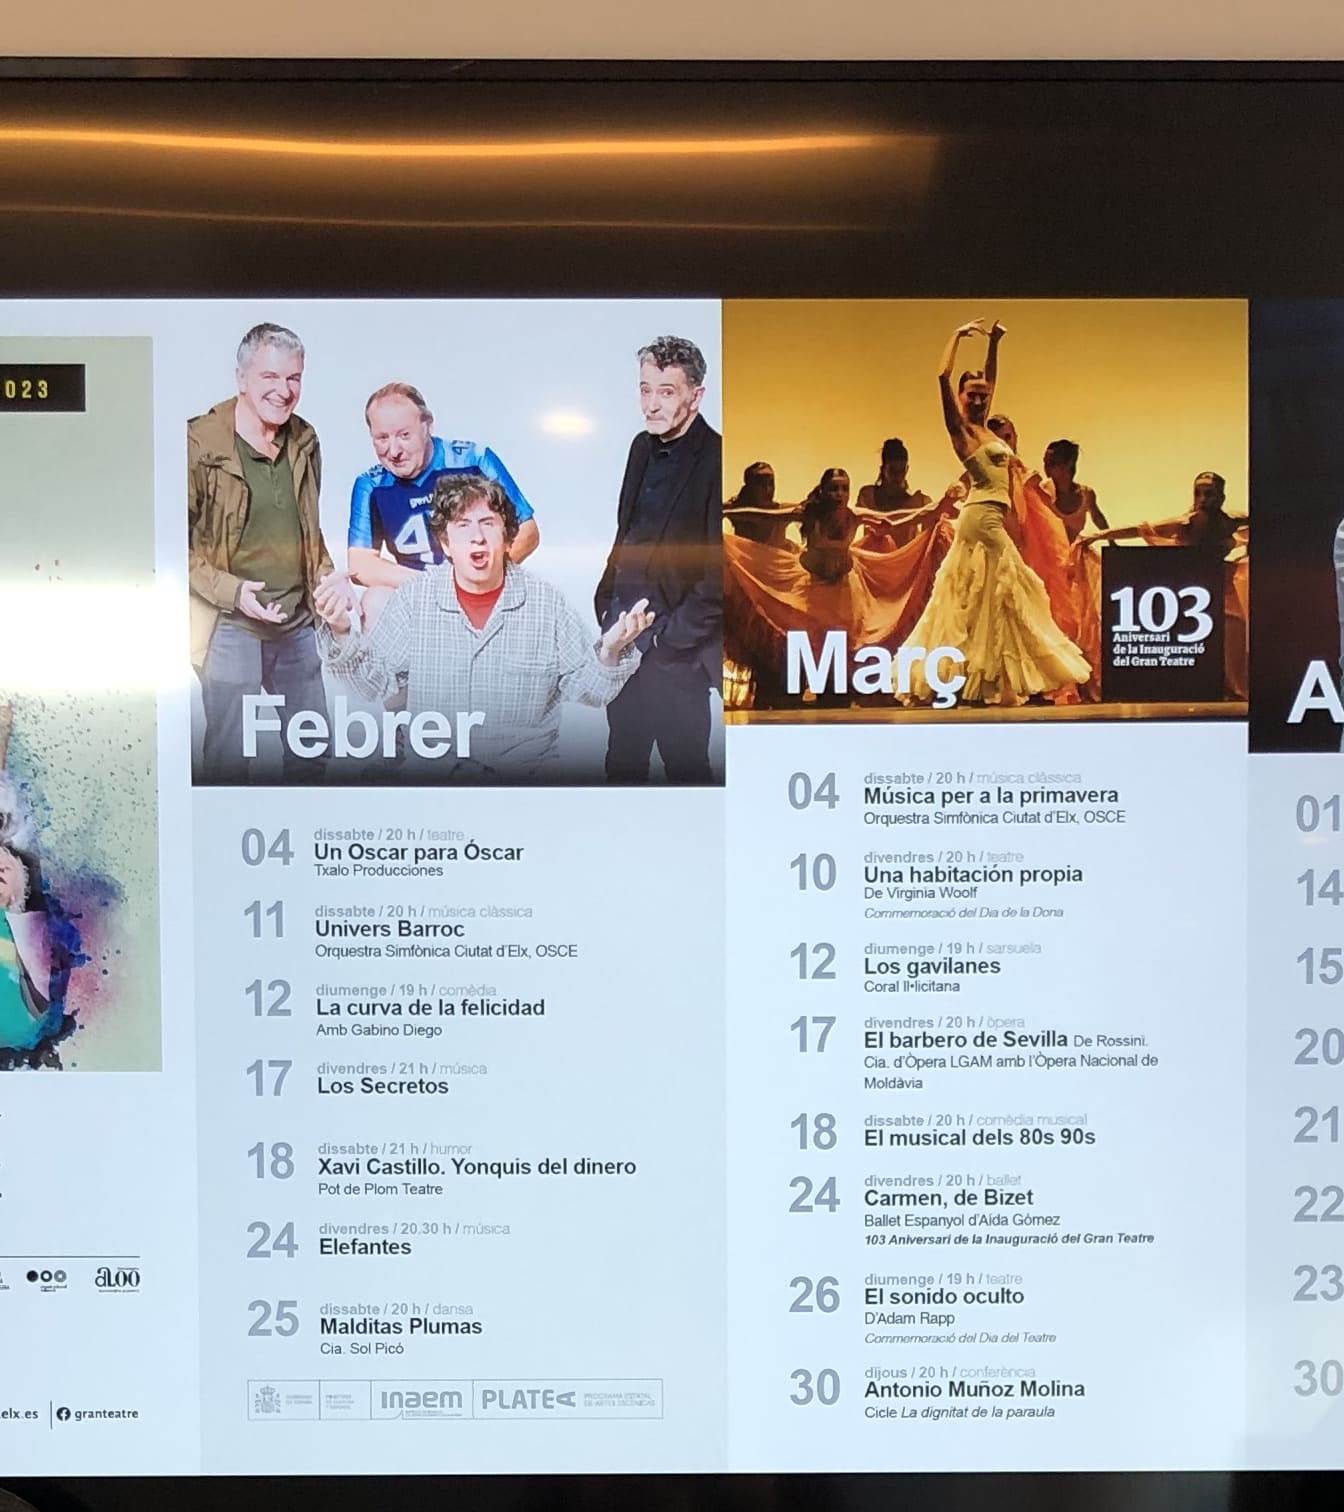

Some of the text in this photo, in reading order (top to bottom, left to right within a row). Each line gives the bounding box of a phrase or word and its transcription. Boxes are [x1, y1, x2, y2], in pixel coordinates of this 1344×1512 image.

[1111, 586, 1213, 644] 103
[1113, 631, 1170, 642] Aniversari
[1113, 643, 1205, 656] de la Inauguració
[787, 629, 967, 708] Març
[1113, 655, 1195, 666] del Gran Teatre
[241, 693, 485, 760] Febrer
[789, 772, 840, 809] 04
[1296, 795, 1340, 832] 01
[242, 828, 294, 865] 04
[315, 839, 524, 862] Un Oscar para Óscar
[314, 864, 443, 876] Txalo Producciones
[791, 853, 836, 891] 10
[865, 865, 1082, 886] Una habitación propia
[1297, 869, 1344, 905] 14
[244, 900, 283, 937] 11
[316, 920, 464, 937] Univers Barroc
[791, 943, 836, 979] 12
[1297, 947, 1343, 984] 15
[245, 979, 291, 1016] 12
[317, 999, 544, 1015] La curva de la felicidad
[317, 1024, 442, 1038] Amb Gabino Diego
[791, 1016, 836, 1052] 17
[865, 1030, 1147, 1048] El barbero de Sevilla De Rossini.
[1295, 1028, 1344, 1065] 20
[247, 1059, 292, 1096] 17
[318, 1077, 448, 1094] Los Secretos
[791, 1113, 837, 1150] 18
[865, 1128, 1095, 1146] El musical dels 80s 90s
[248, 1142, 294, 1179] 18
[319, 1158, 636, 1178] Xavi Castillo. Yonquis del dinero
[319, 1183, 443, 1195] Pot de Plom Teatre
[789, 1176, 840, 1212] 24
[865, 1189, 1033, 1209] Carmen, de Bizet
[247, 1221, 298, 1258] 24
[320, 1238, 411, 1254] Elefantes
[789, 1276, 840, 1313] 26
[865, 1288, 1024, 1304] El sonido oculto
[248, 1300, 299, 1336] 25
[321, 1318, 482, 1334] Malditas Plumas
[790, 1369, 840, 1405] 30
[865, 1379, 1084, 1397] Antonio Muñoz Molina
[75, 1410, 138, 1421] granteatre
